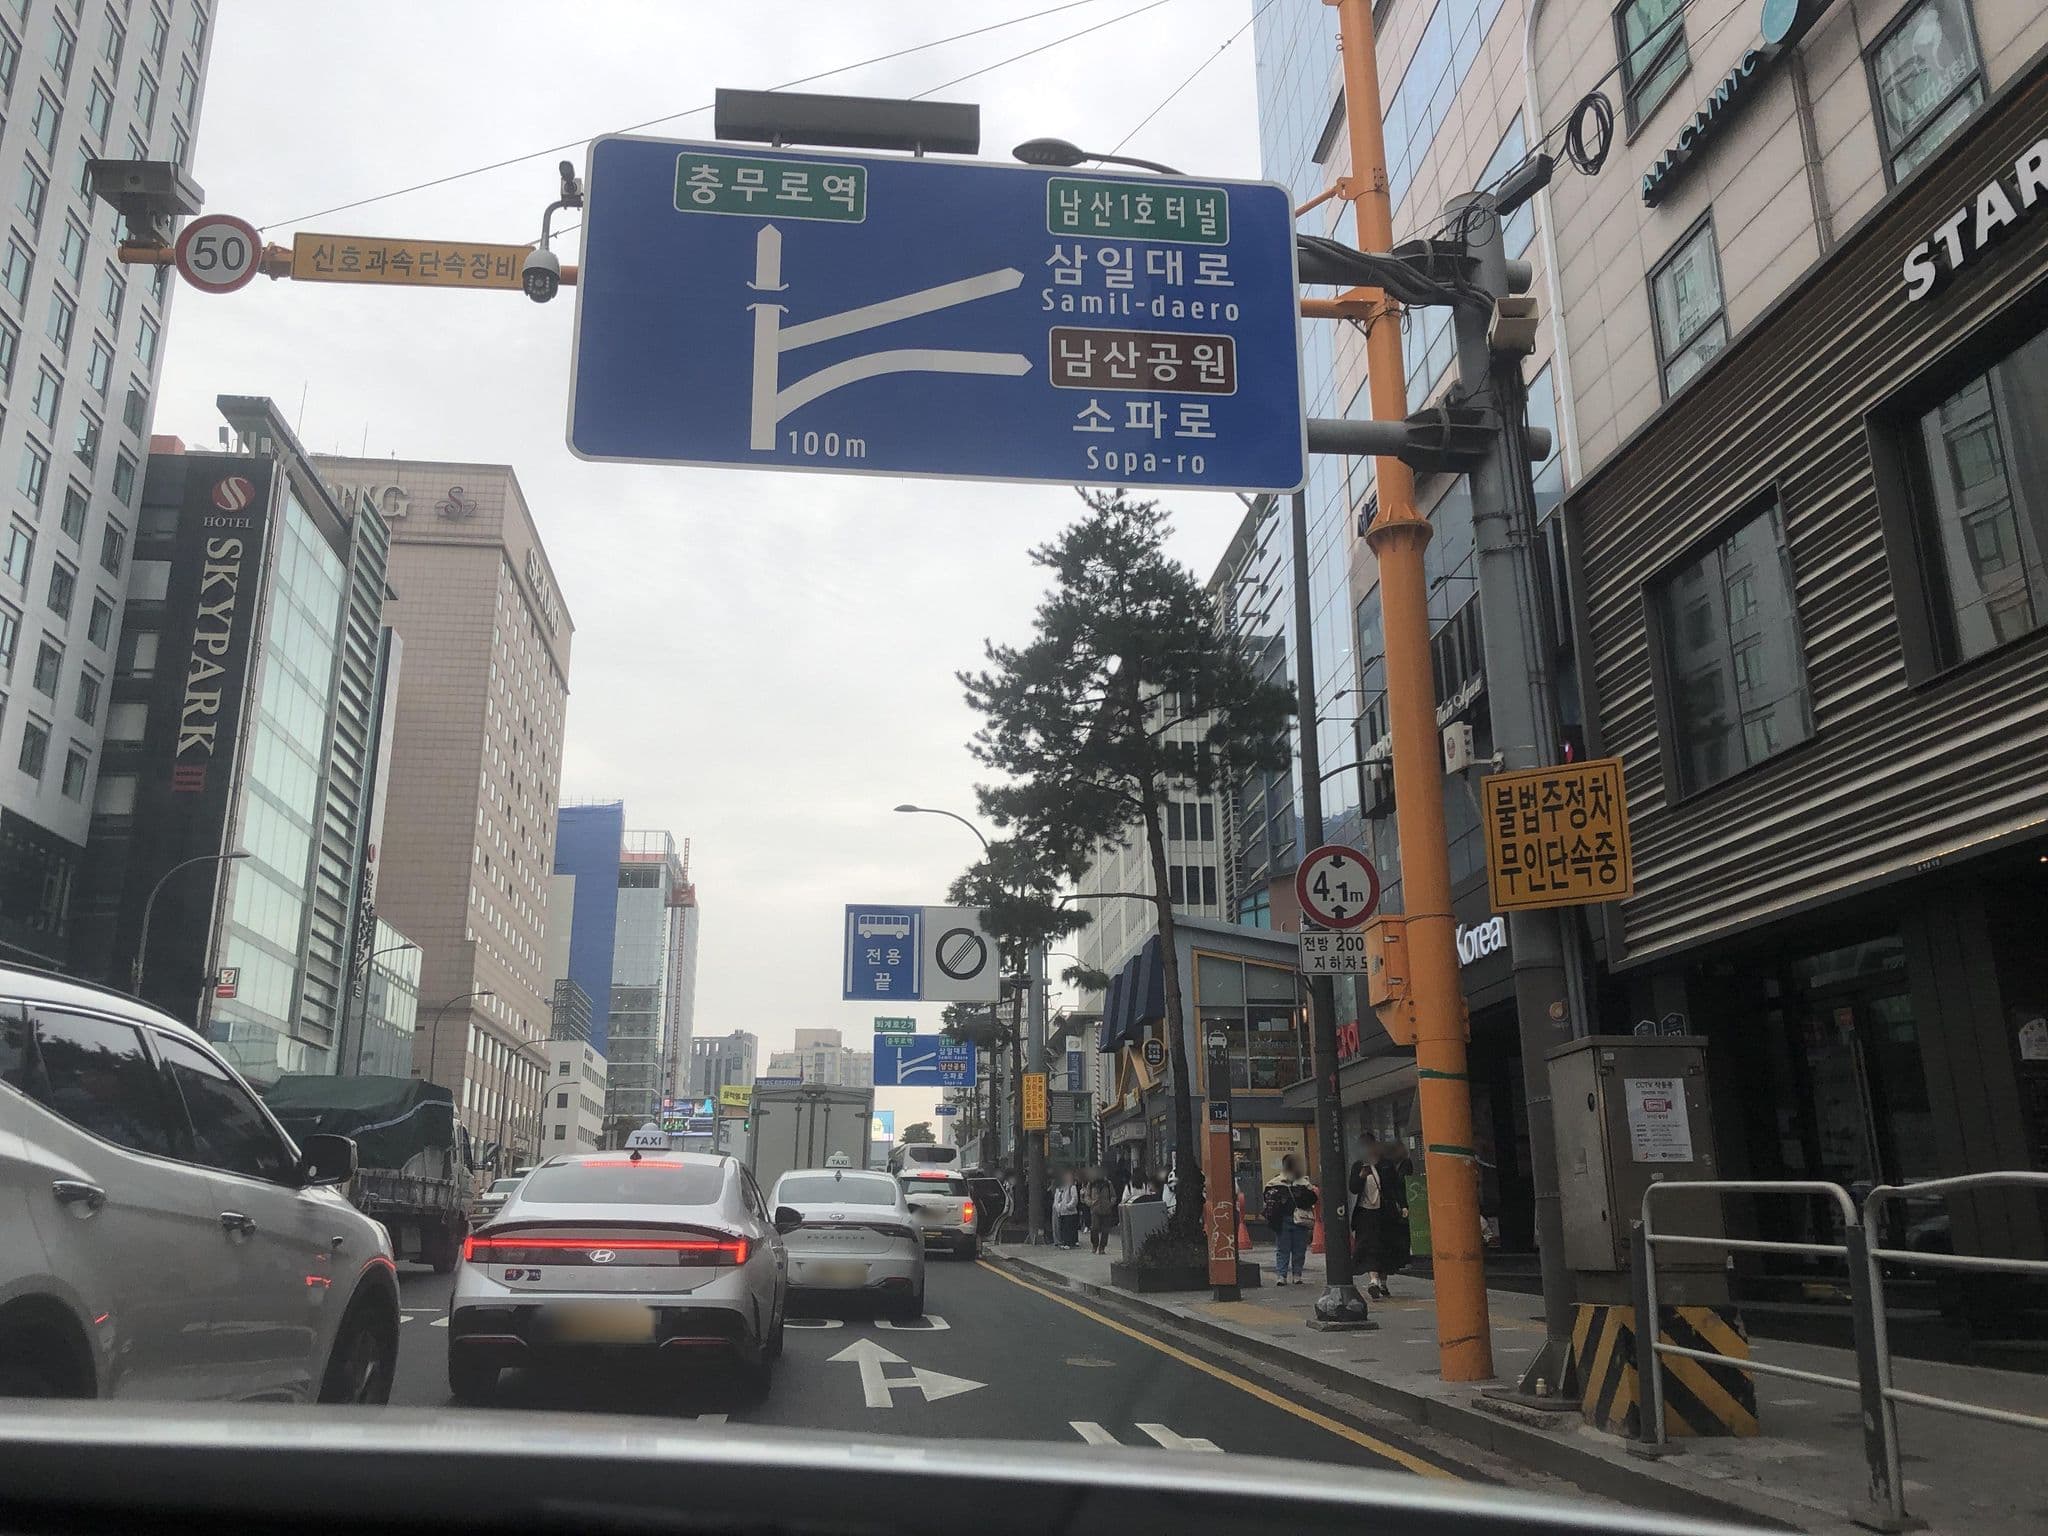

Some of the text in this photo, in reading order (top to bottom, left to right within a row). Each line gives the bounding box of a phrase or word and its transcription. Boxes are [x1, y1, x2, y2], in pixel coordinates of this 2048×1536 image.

[1642, 48, 1761, 201] ALL CLINIC
[686, 164, 855, 212] 충무로역
[1060, 189, 1217, 236] 남산1호터널
[193, 237, 246, 271] 50
[312, 243, 518, 281] 신호과속단속장비
[1045, 244, 1235, 290] 삼일대로
[1042, 288, 1240, 322] Samil-daero
[1060, 339, 1226, 385] 남산공원
[1072, 399, 1217, 439] 소파로
[788, 430, 866, 458] 100m
[1086, 446, 1206, 475] Sopa-ro
[204, 515, 254, 529] HOTEL
[176, 537, 243, 759] SKYPARK
[1495, 771, 1613, 837] 불법주정차
[1500, 832, 1617, 896] 무인단속중
[1312, 870, 1364, 902] 4.1m
[866, 948, 901, 966] 전용
[1304, 936, 1328, 952] 전방
[874, 972, 891, 991] 끝
[634, 1135, 663, 1146] TAXI
